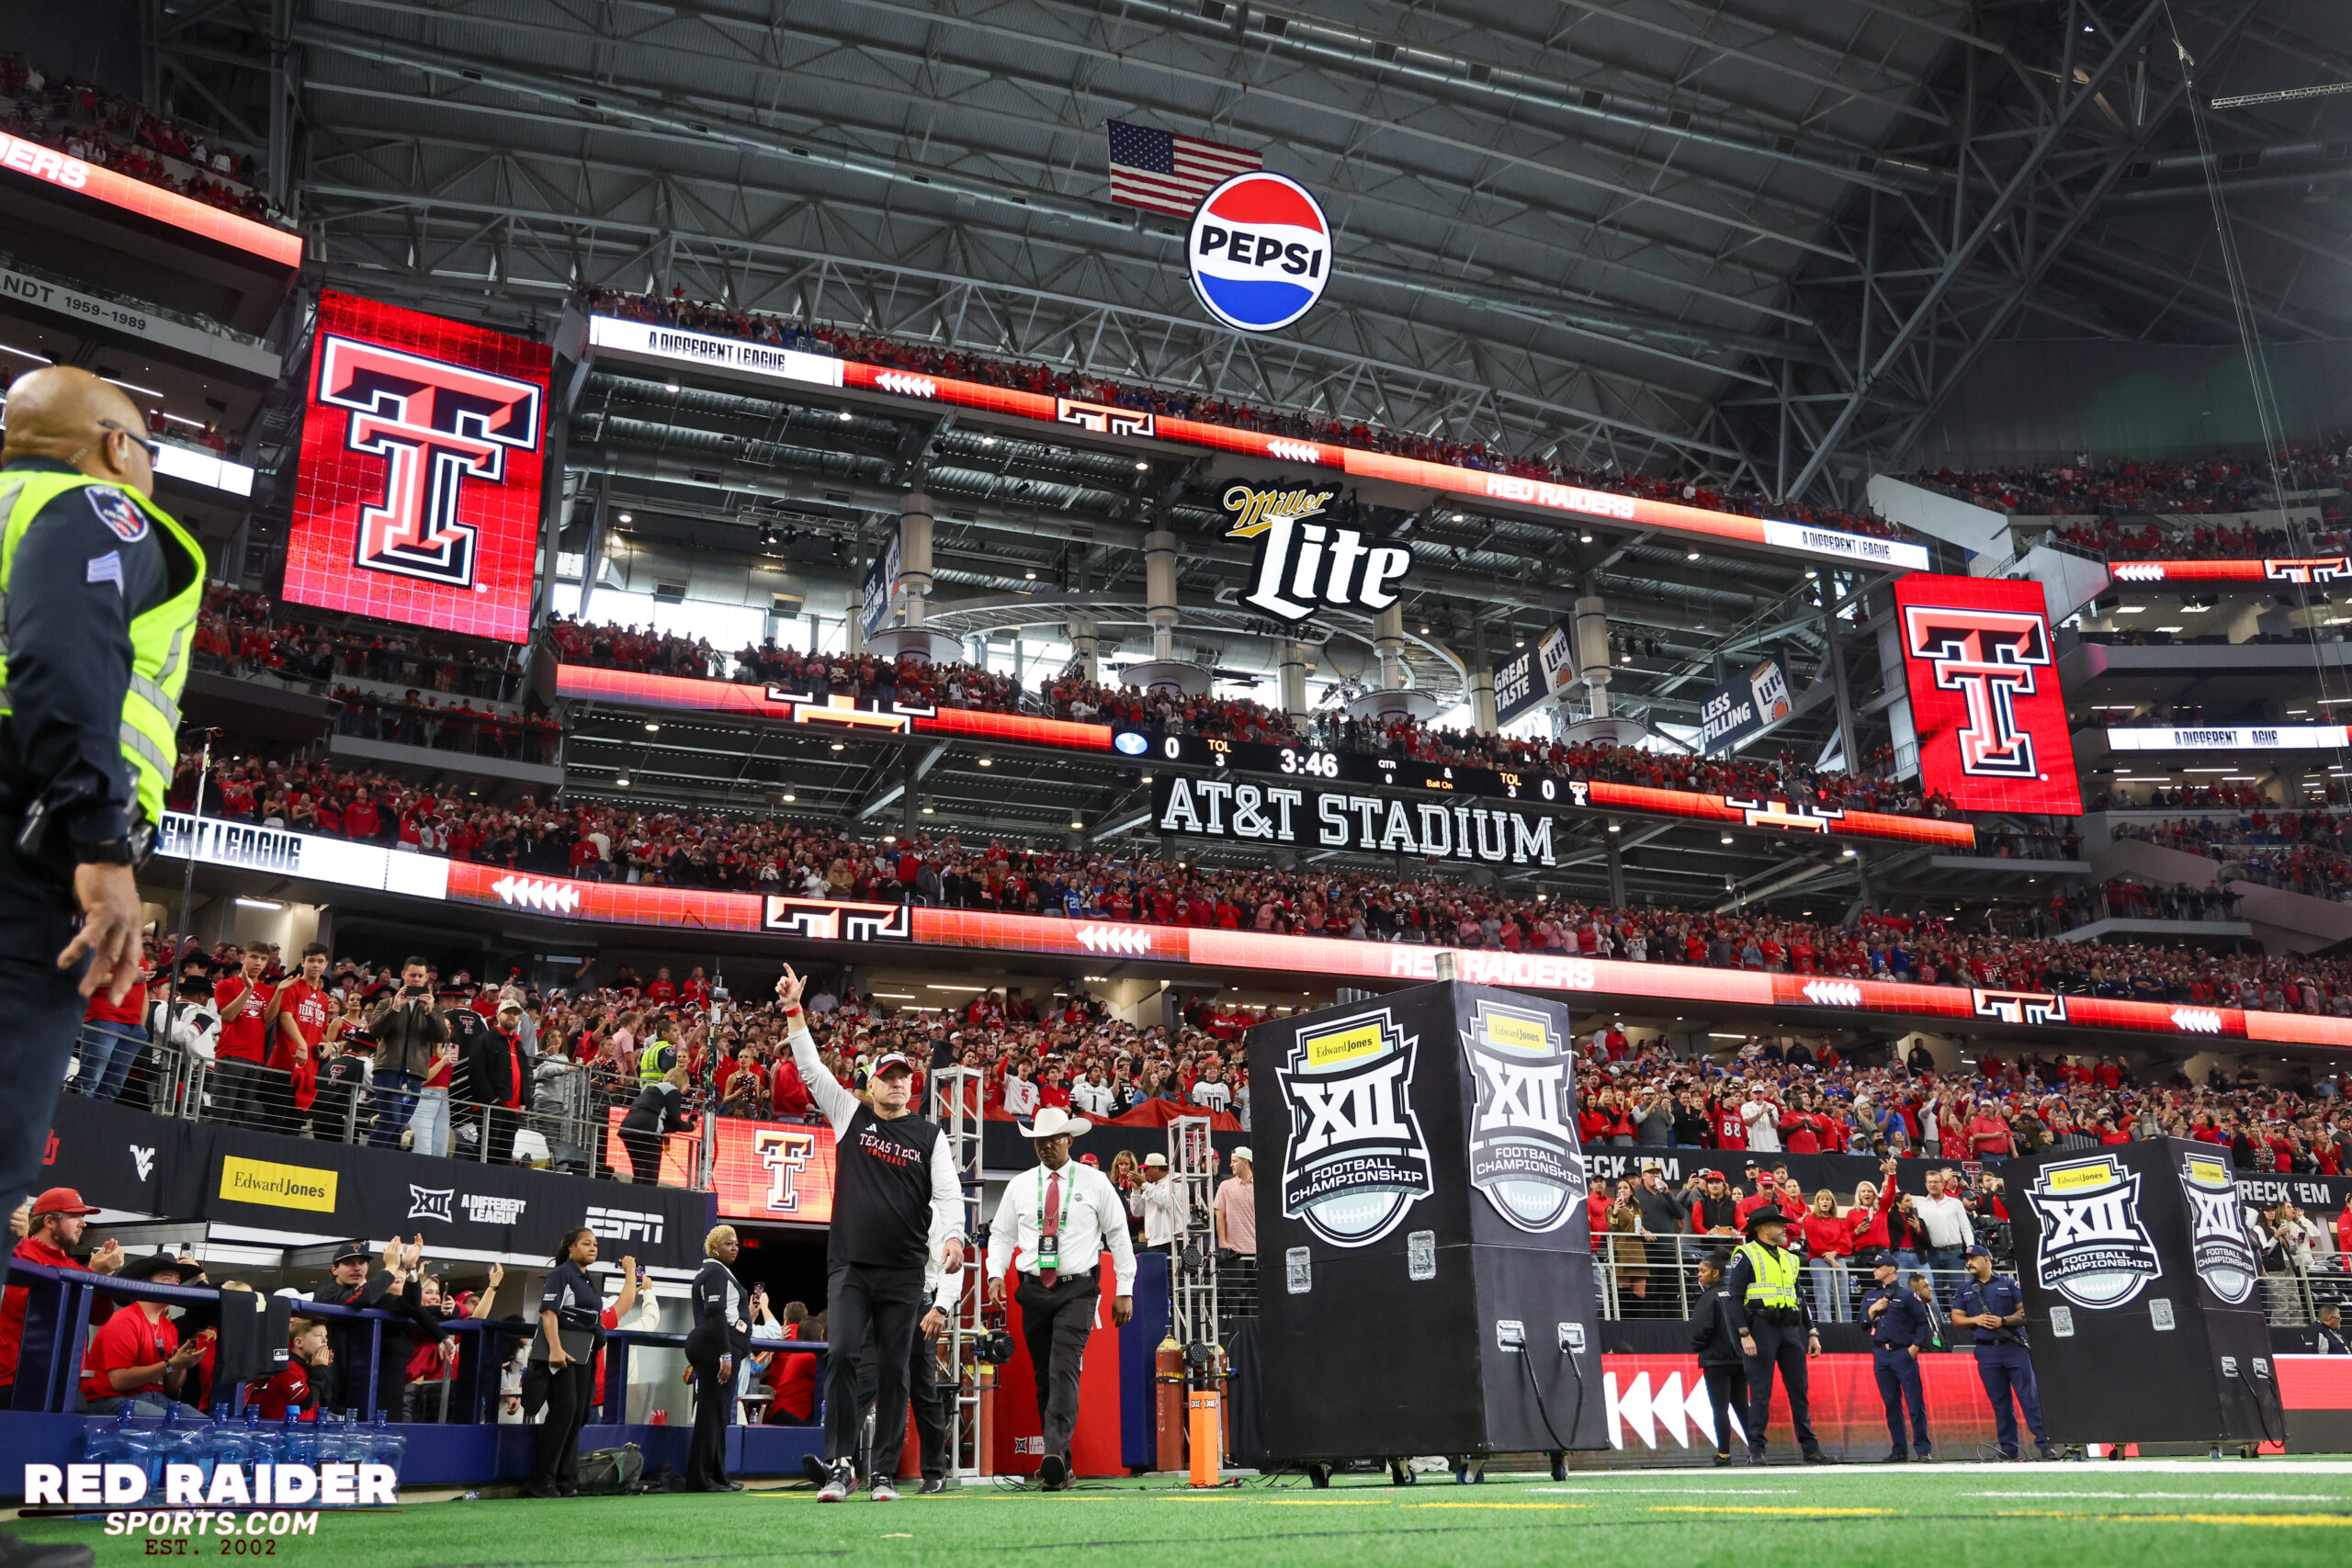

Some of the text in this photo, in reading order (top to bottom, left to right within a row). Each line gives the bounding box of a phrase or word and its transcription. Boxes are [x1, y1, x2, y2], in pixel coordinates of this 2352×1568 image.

[1199, 225, 1322, 277] PEPSI
[0, 275, 54, 302] NDT
[649, 331, 785, 371] A DIFFERENT LEAGUE
[1487, 474, 1634, 518] RED RAIDERS
[1223, 486, 1410, 619] Miller Lite
[1803, 531, 1891, 559] A DIFFERENT LEAGUE
[1545, 636, 1566, 673] Lite
[1495, 653, 1530, 692] GREAT
[1495, 675, 1530, 712] TASTE
[1758, 671, 1782, 705] Lite
[1702, 692, 1730, 724] LESS
[1703, 702, 1751, 743] FILLING
[1165, 737, 1180, 759] 0
[1208, 739, 1232, 753] TOL
[2175, 731, 2182, 746] A
[2184, 730, 2238, 746] DIFFERENT
[1216, 753, 1225, 767] 3
[1280, 749, 1338, 777] 3:46
[1378, 760, 1396, 770] QTR
[1426, 779, 1453, 790] Ball On
[1443, 768, 1453, 779] &
[1499, 773, 1521, 785] TOL
[1508, 785, 1516, 797] 3
[1542, 779, 1555, 800] 0
[1160, 777, 1556, 866] AT&T STADIUM
[160, 814, 302, 872] ENT LEAGUE
[1463, 951, 1595, 989] RAIDERS
[1494, 1023, 1540, 1043] Edward Jones
[1316, 1037, 1373, 1058] Edward Jones
[1021, 1089, 1029, 1104] 5
[1091, 1095, 1097, 1112] 1
[1207, 1096, 1222, 1114] 10
[1723, 1122, 1741, 1138] 88
[860, 1133, 922, 1163] TEXAS TECH
[867, 1148, 908, 1167] FOOTBALL
[1496, 1147, 1561, 1168] FOOTBALL
[1312, 1158, 1396, 1183] FOOTBALL
[1476, 1162, 1581, 1185] CHAMPIONSHIP
[1582, 1155, 1627, 1179] ECK
[233, 1171, 325, 1199] Edward Jones
[1290, 1170, 1423, 1204] CHAMPIONSHIP
[2058, 1171, 2104, 1186] Edward Jones
[2238, 1180, 2292, 1202] RECK
[461, 1194, 526, 1213] A DIFFERENT
[469, 1209, 516, 1224] LEAGUE
[584, 1206, 663, 1244] ESPN
[2062, 1251, 2131, 1267] FOOTBALL
[2199, 1256, 2253, 1272] CHAMPIONSHIP
[2206, 1247, 2242, 1260] FOOTBALL
[2044, 1258, 2153, 1280] CHAMPIONSHIP
